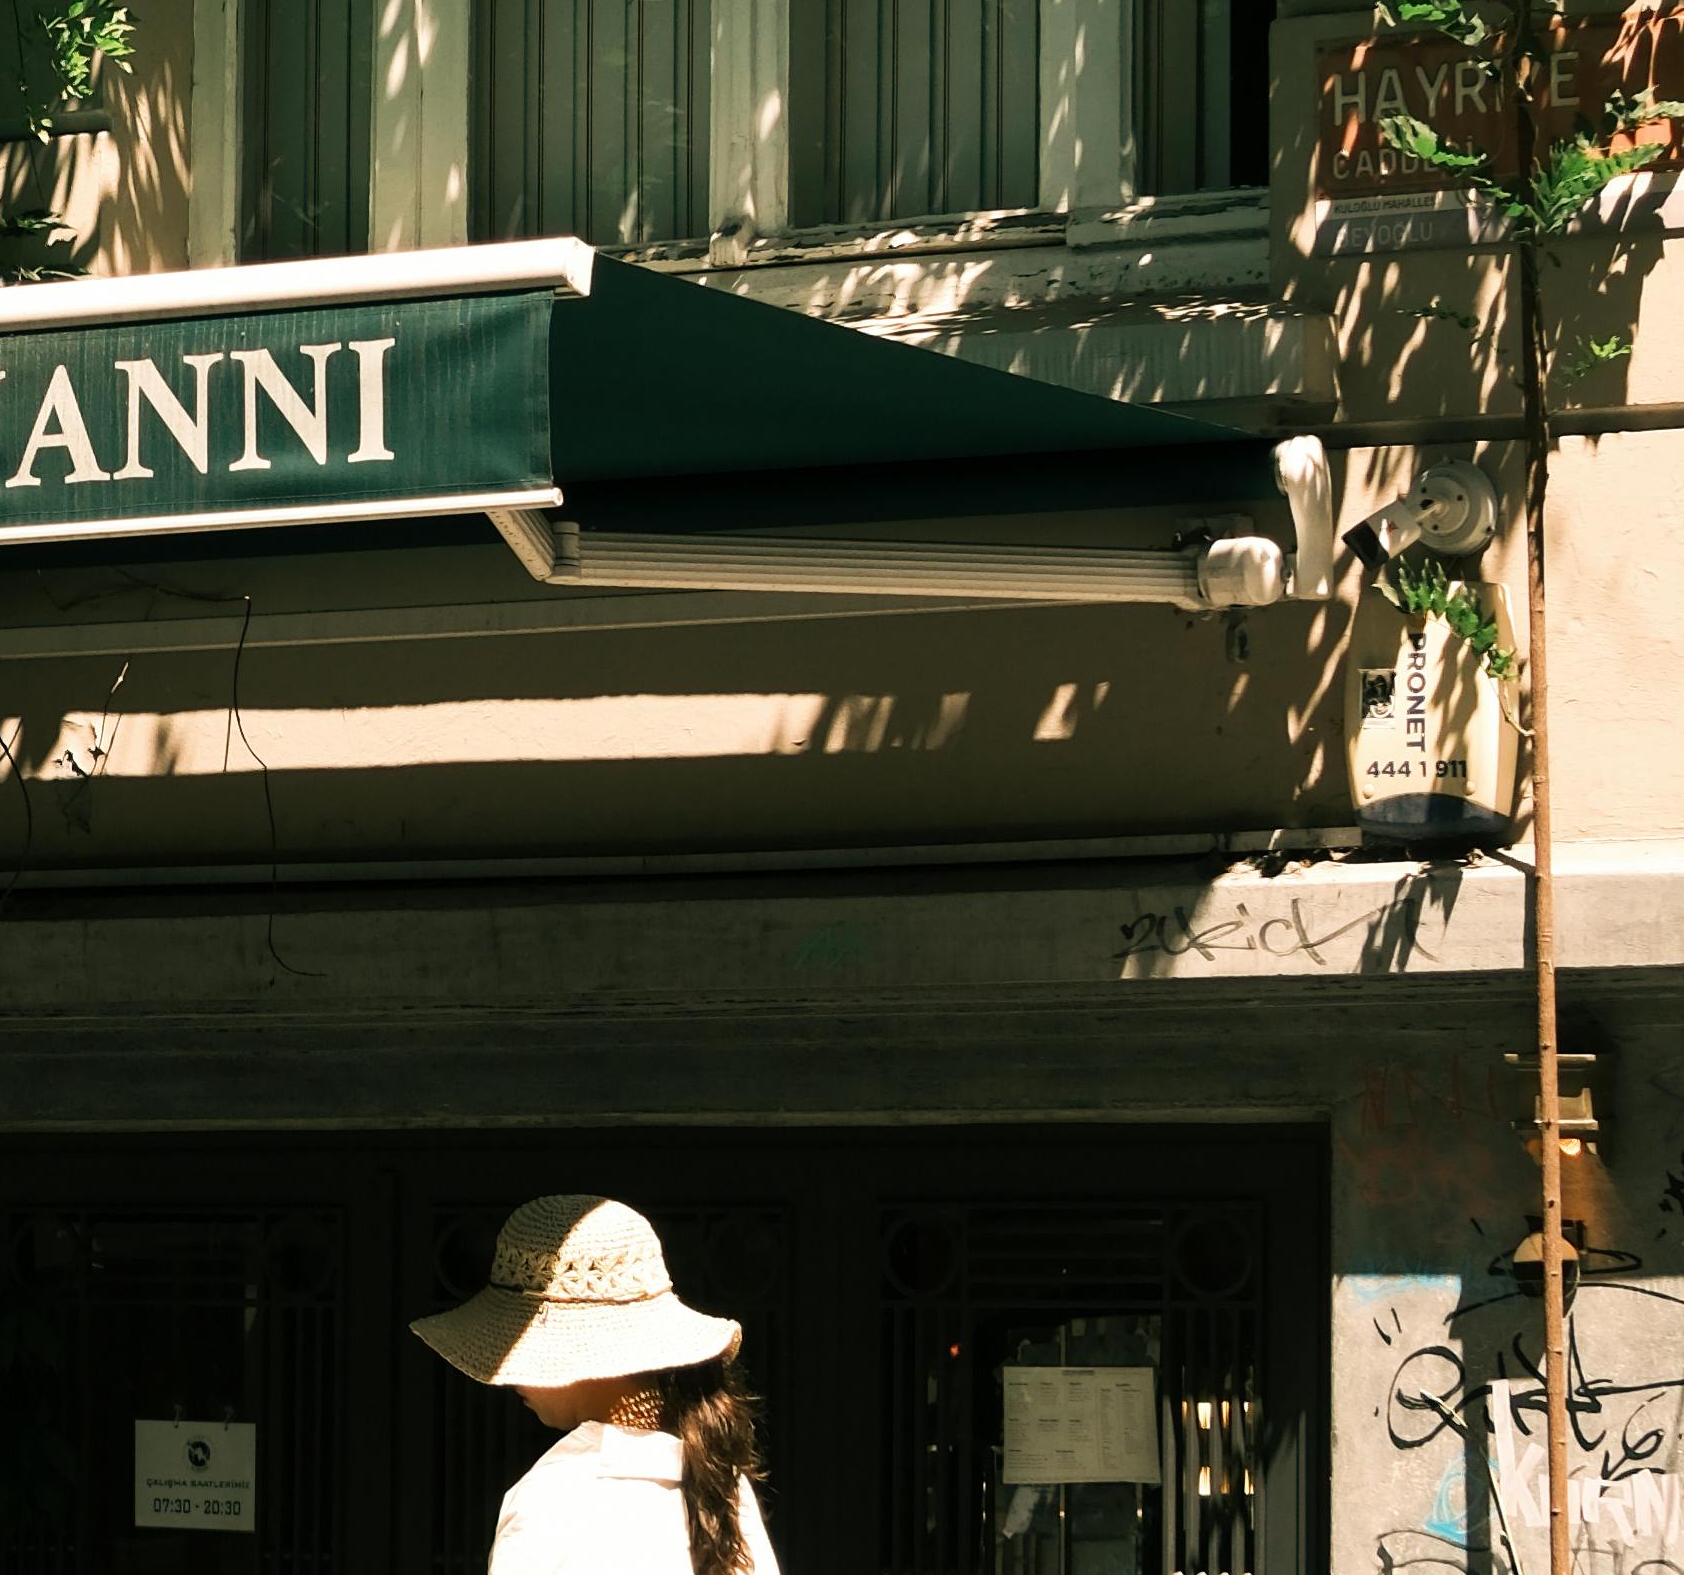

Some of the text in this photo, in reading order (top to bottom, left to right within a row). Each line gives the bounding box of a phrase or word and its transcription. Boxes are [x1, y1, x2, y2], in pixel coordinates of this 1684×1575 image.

[1333, 51, 1581, 126] HAYRE
[1332, 135, 1476, 180] CADDİ
[1366, 760, 1412, 779] 444
[1435, 759, 1468, 778] 911
[153, 1497, 191, 1514] 07:30
[204, 1499, 241, 1516] 20:30
